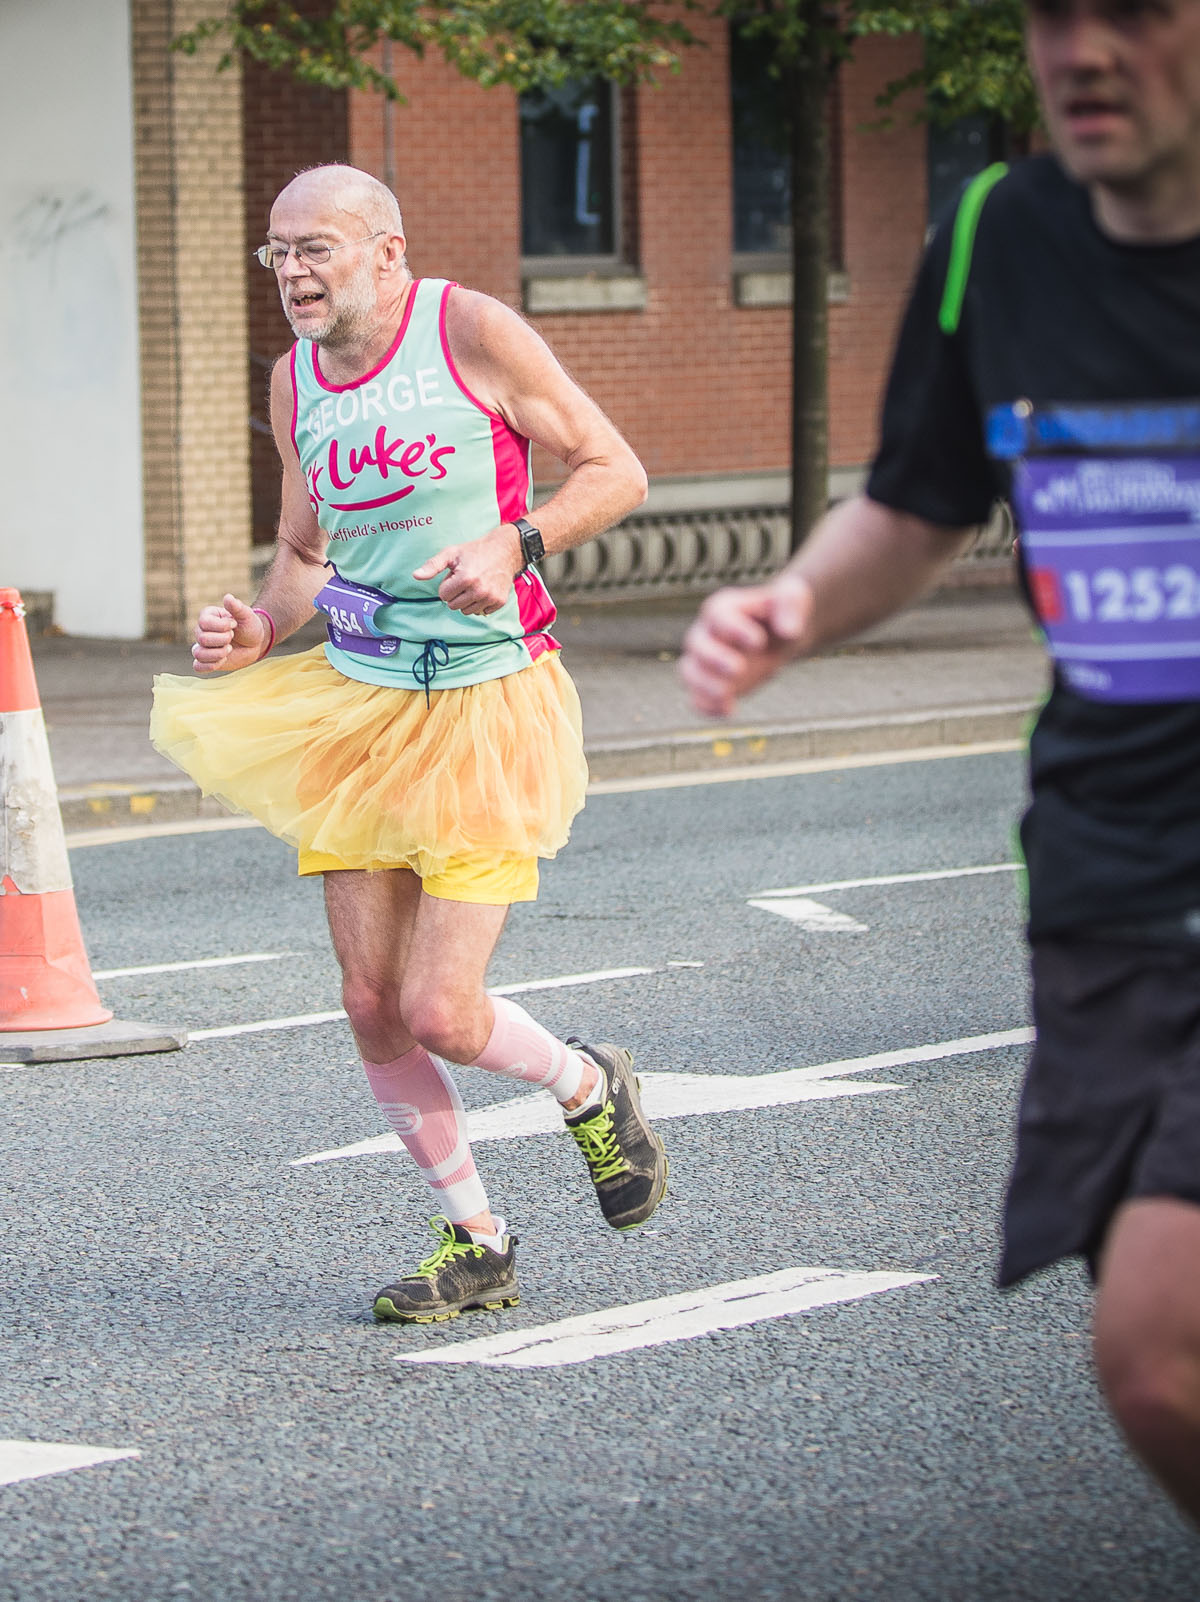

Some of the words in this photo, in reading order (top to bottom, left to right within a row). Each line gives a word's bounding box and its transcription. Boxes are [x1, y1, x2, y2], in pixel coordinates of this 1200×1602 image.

[307, 367, 443, 441] GEORGE
[329, 425, 456, 490] Luke's
[379, 515, 433, 532] Hospice
[1065, 565, 1200, 622] 1252
